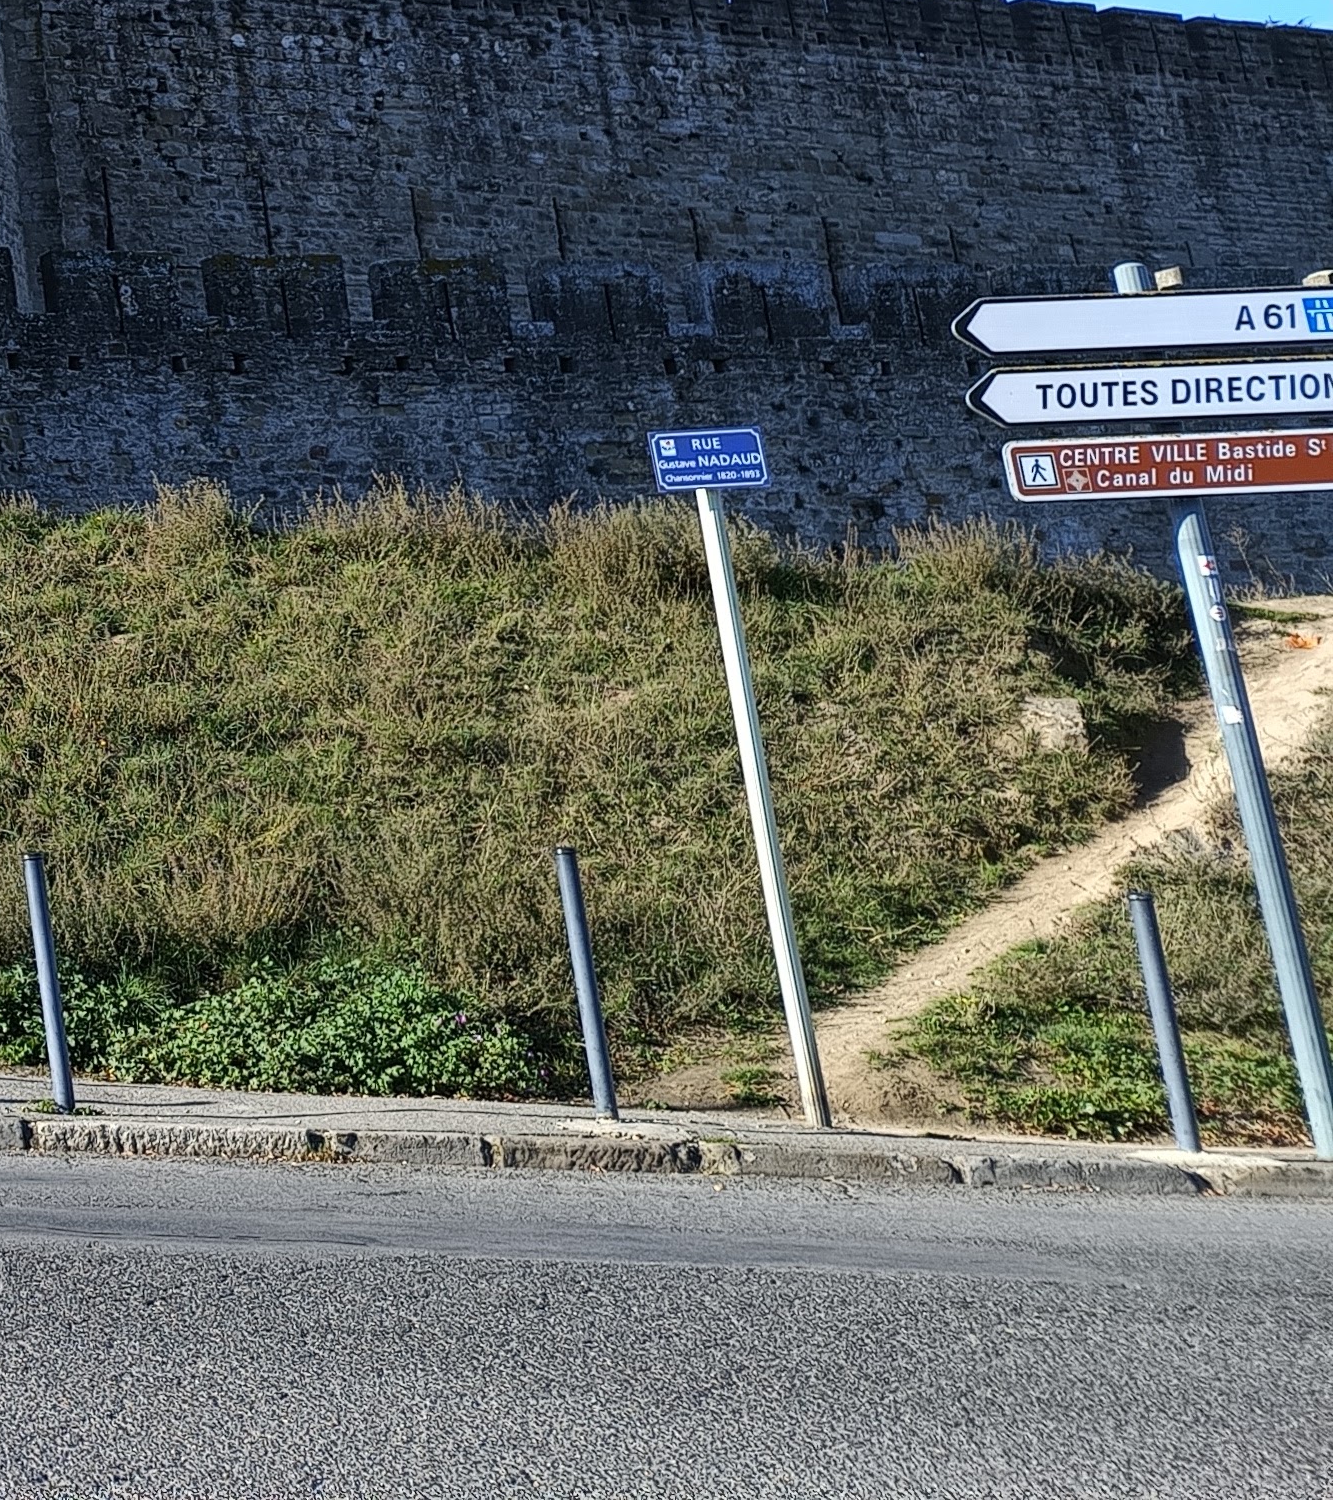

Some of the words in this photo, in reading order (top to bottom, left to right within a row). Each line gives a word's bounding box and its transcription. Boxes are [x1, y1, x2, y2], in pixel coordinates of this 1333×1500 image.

[1235, 305, 1256, 331] A
[1263, 303, 1296, 329] 61
[1036, 380, 1159, 410] TOUTES
[691, 437, 722, 450] RUE
[1059, 446, 1140, 467] CENTRE
[1151, 443, 1208, 463] VILLE
[1218, 440, 1297, 460] Bastide
[1308, 438, 1327, 456] St
[658, 459, 697, 469] Gustave
[698, 452, 761, 467] NADAUD
[665, 471, 713, 482] Chansonnier
[1097, 467, 1157, 487] Canal
[1169, 466, 1194, 485] du
[1206, 463, 1254, 483] Midi
